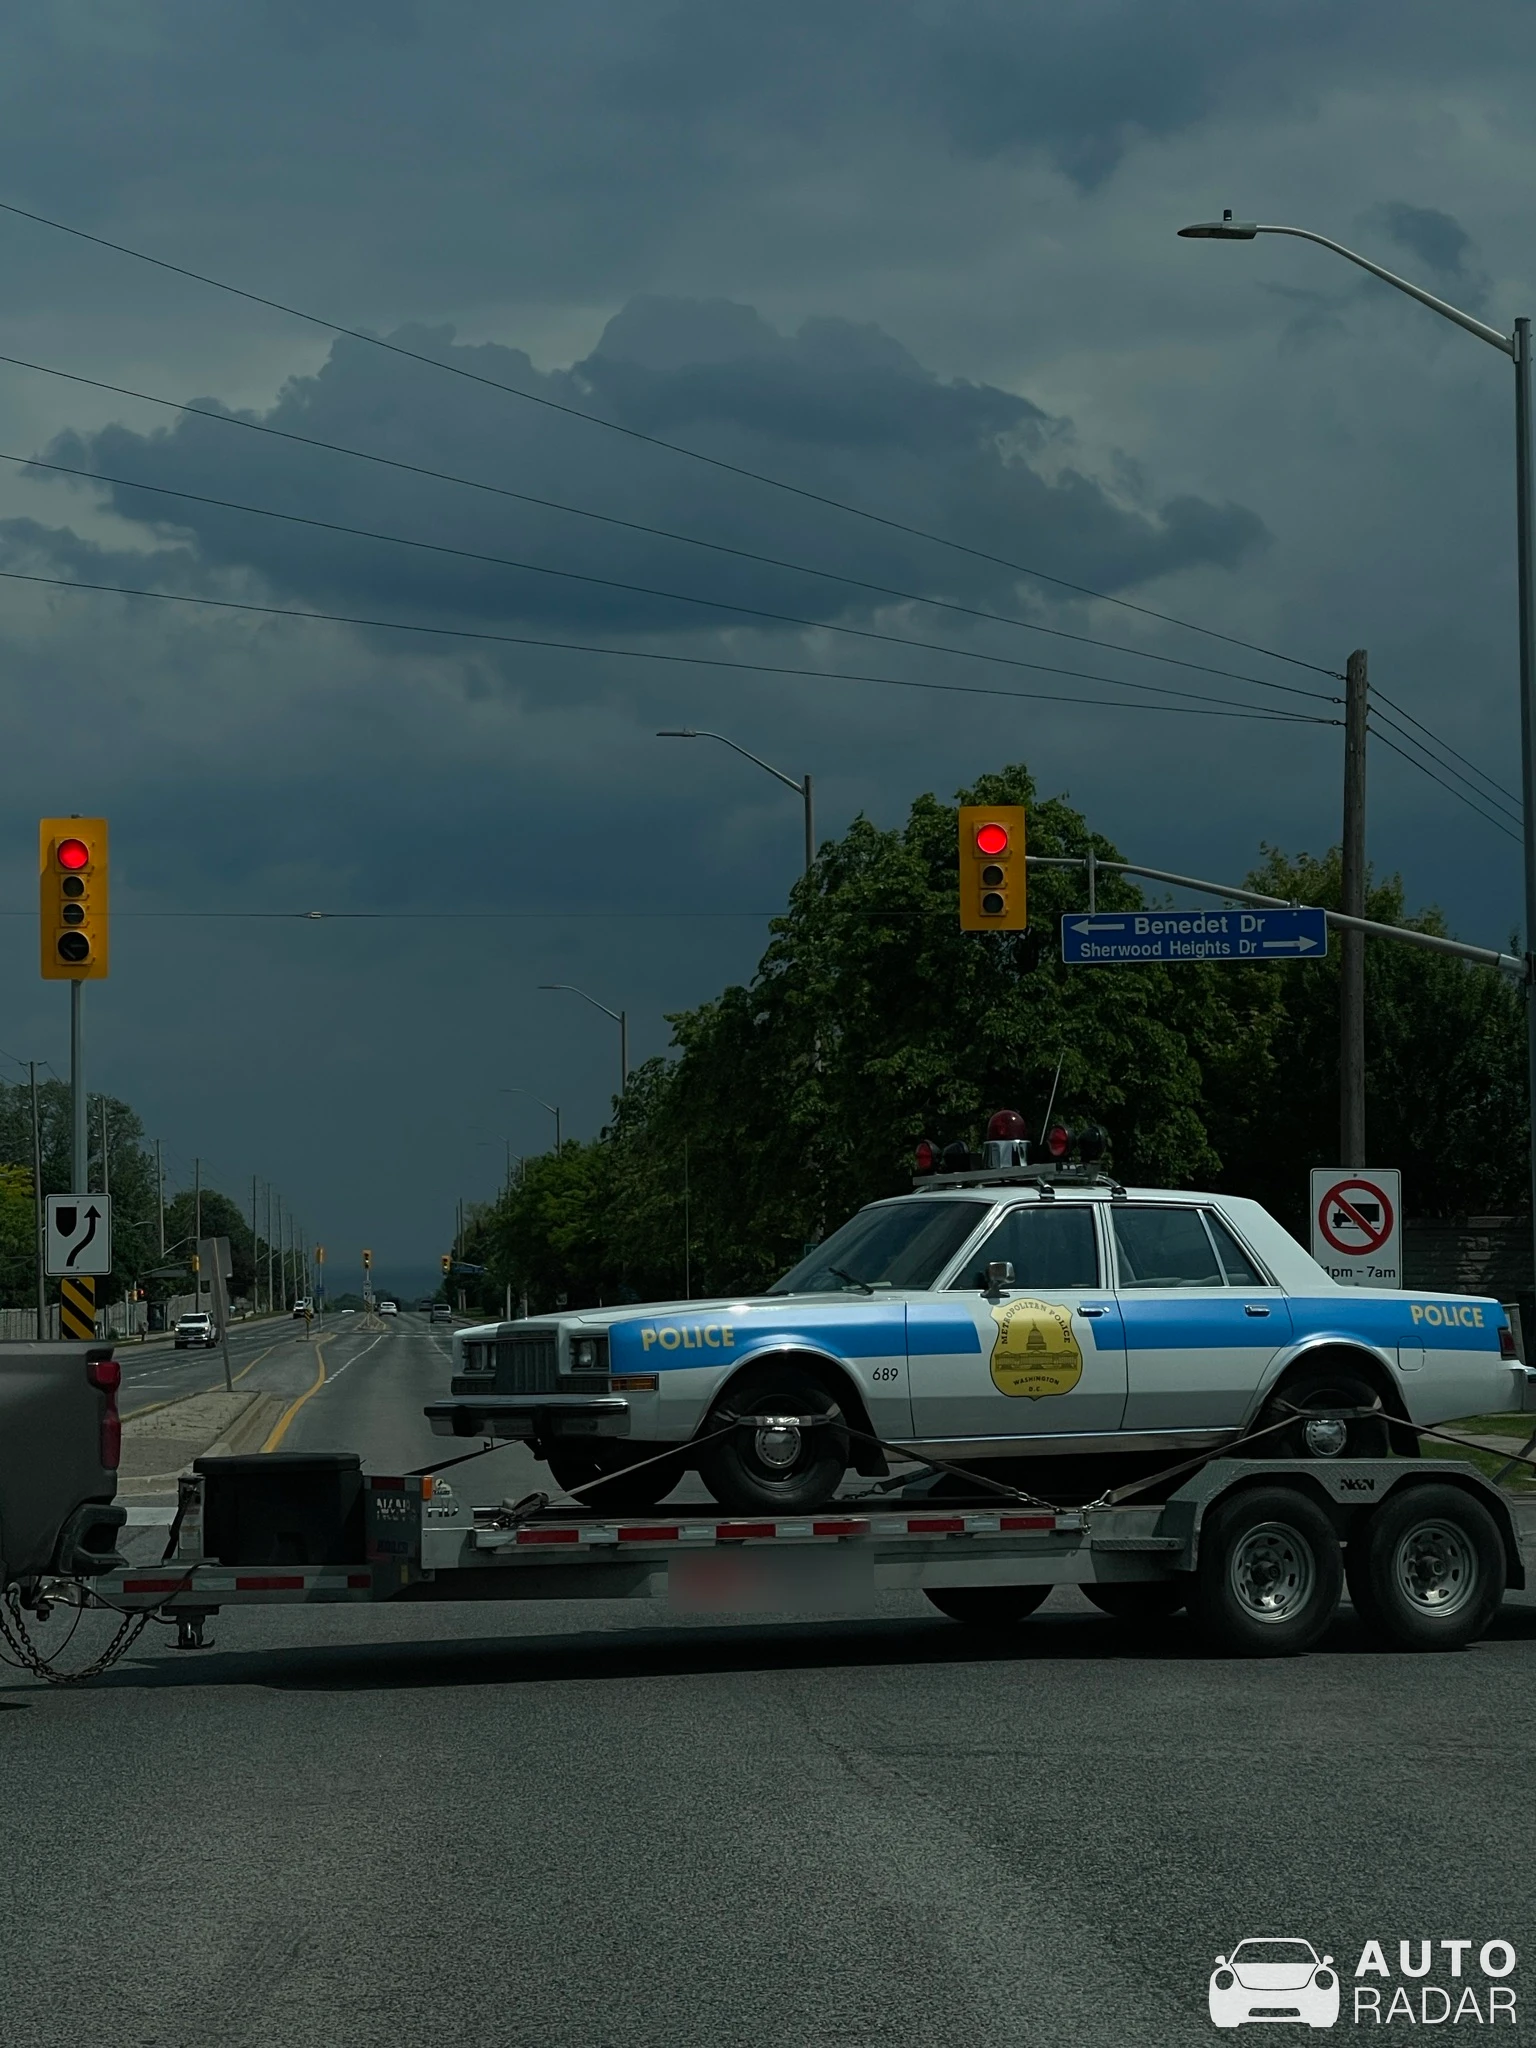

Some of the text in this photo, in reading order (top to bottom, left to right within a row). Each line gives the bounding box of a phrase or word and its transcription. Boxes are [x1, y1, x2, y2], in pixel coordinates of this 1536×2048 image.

[1134, 914, 1266, 935] Benedet Dr
[1080, 939, 1257, 958] Sherwood Heights Dr
[1321, 1265, 1353, 1280] 1pm
[1366, 1265, 1396, 1278] 7am
[1001, 1302, 1071, 1345] METROPOLITAN POLICE
[1410, 1305, 1485, 1328] POLICE
[641, 1325, 735, 1351] POLICE
[872, 1367, 899, 1382] 689
[1013, 1376, 1060, 1386] WASHINGTON
